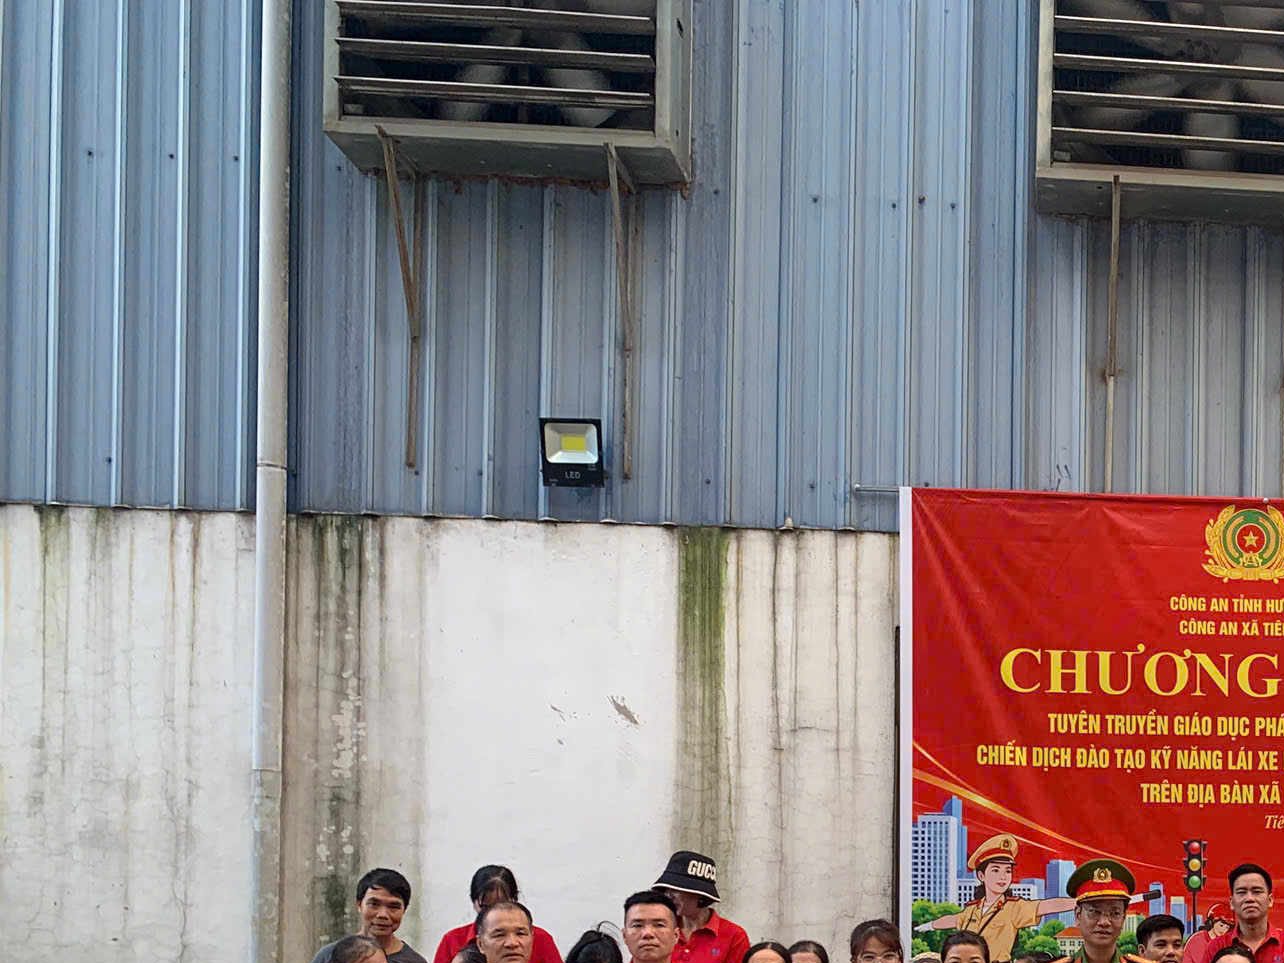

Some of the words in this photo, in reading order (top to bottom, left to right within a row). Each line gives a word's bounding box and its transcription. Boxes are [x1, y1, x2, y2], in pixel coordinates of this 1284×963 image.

[565, 471, 581, 479] LED
[1169, 593, 1206, 612] CÔNG
[1210, 597, 1229, 612] AN
[1232, 594, 1262, 613] TỈNH
[1179, 617, 1216, 635] CÔNG
[1219, 621, 1238, 635] AN
[1241, 619, 1259, 636] XÃ
[1000, 643, 1283, 698] CHƯƠNG
[1047, 710, 1101, 734] TUYÊN
[1104, 709, 1169, 736] TRUYỀN
[1173, 711, 1212, 736] GIÁO
[1217, 716, 1250, 741] DỤC
[976, 740, 1027, 767] CHIẾN
[1032, 747, 1072, 772] DỊCH
[1075, 744, 1110, 769] ĐÀO
[1114, 748, 1146, 773] TẠO
[1150, 745, 1172, 769] KỸ
[1176, 745, 1223, 770] NĂNG
[1227, 747, 1253, 771] LÁI
[1257, 750, 1279, 771] XE
[1140, 779, 1183, 804] TRÊN
[1186, 783, 1216, 808] ĐỊA
[1220, 779, 1254, 804] BÀN
[1258, 780, 1281, 805] XÃ
[687, 859, 717, 880] GUCC
